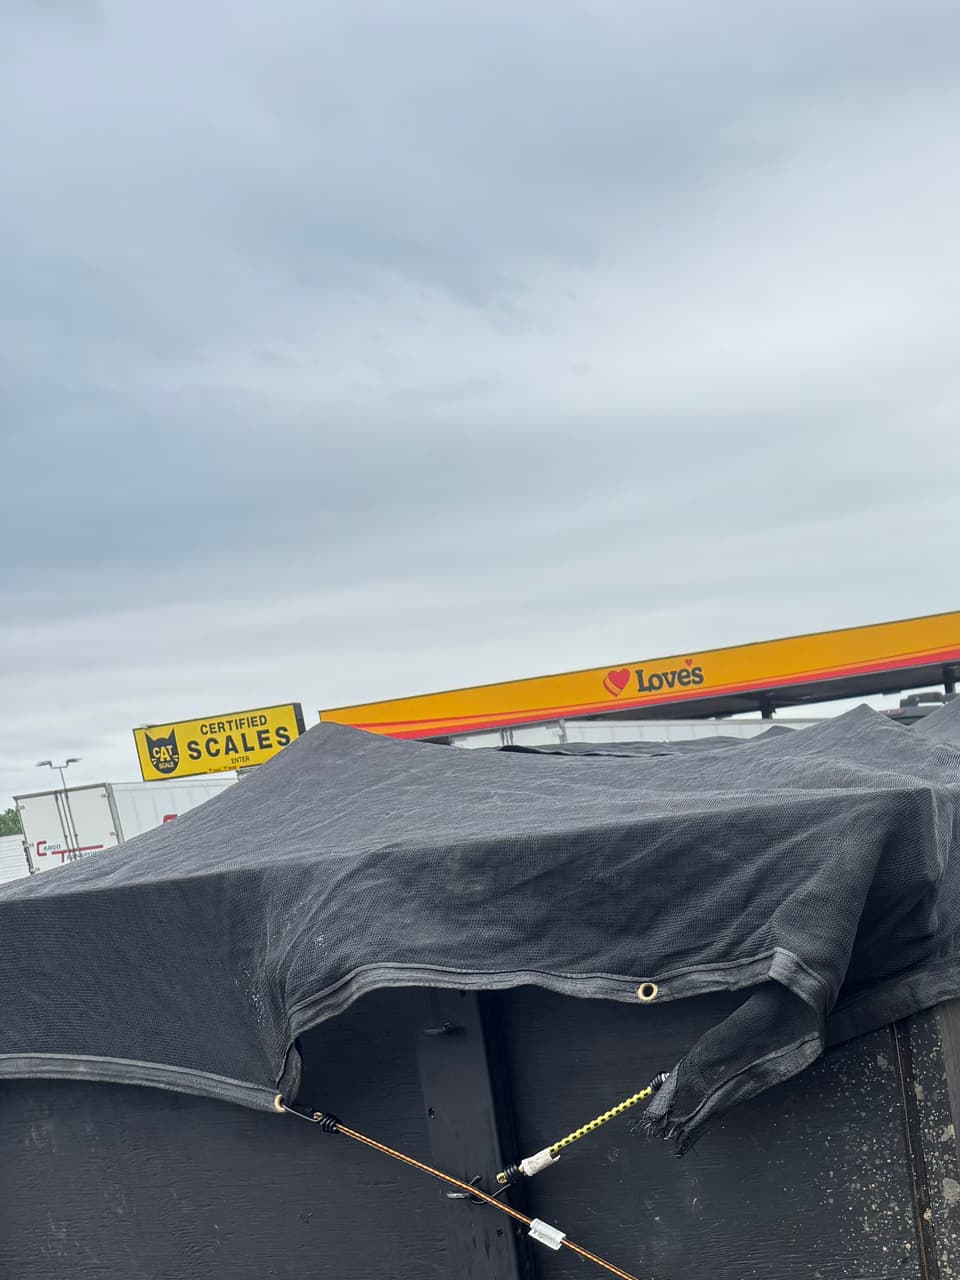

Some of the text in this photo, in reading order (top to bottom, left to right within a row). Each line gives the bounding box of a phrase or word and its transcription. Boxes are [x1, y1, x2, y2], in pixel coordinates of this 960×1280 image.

[200, 715, 267, 735] CERTIFIED
[187, 726, 291, 760] SCALES
[152, 745, 173, 761] CAT
[231, 756, 250, 764] ENTER
